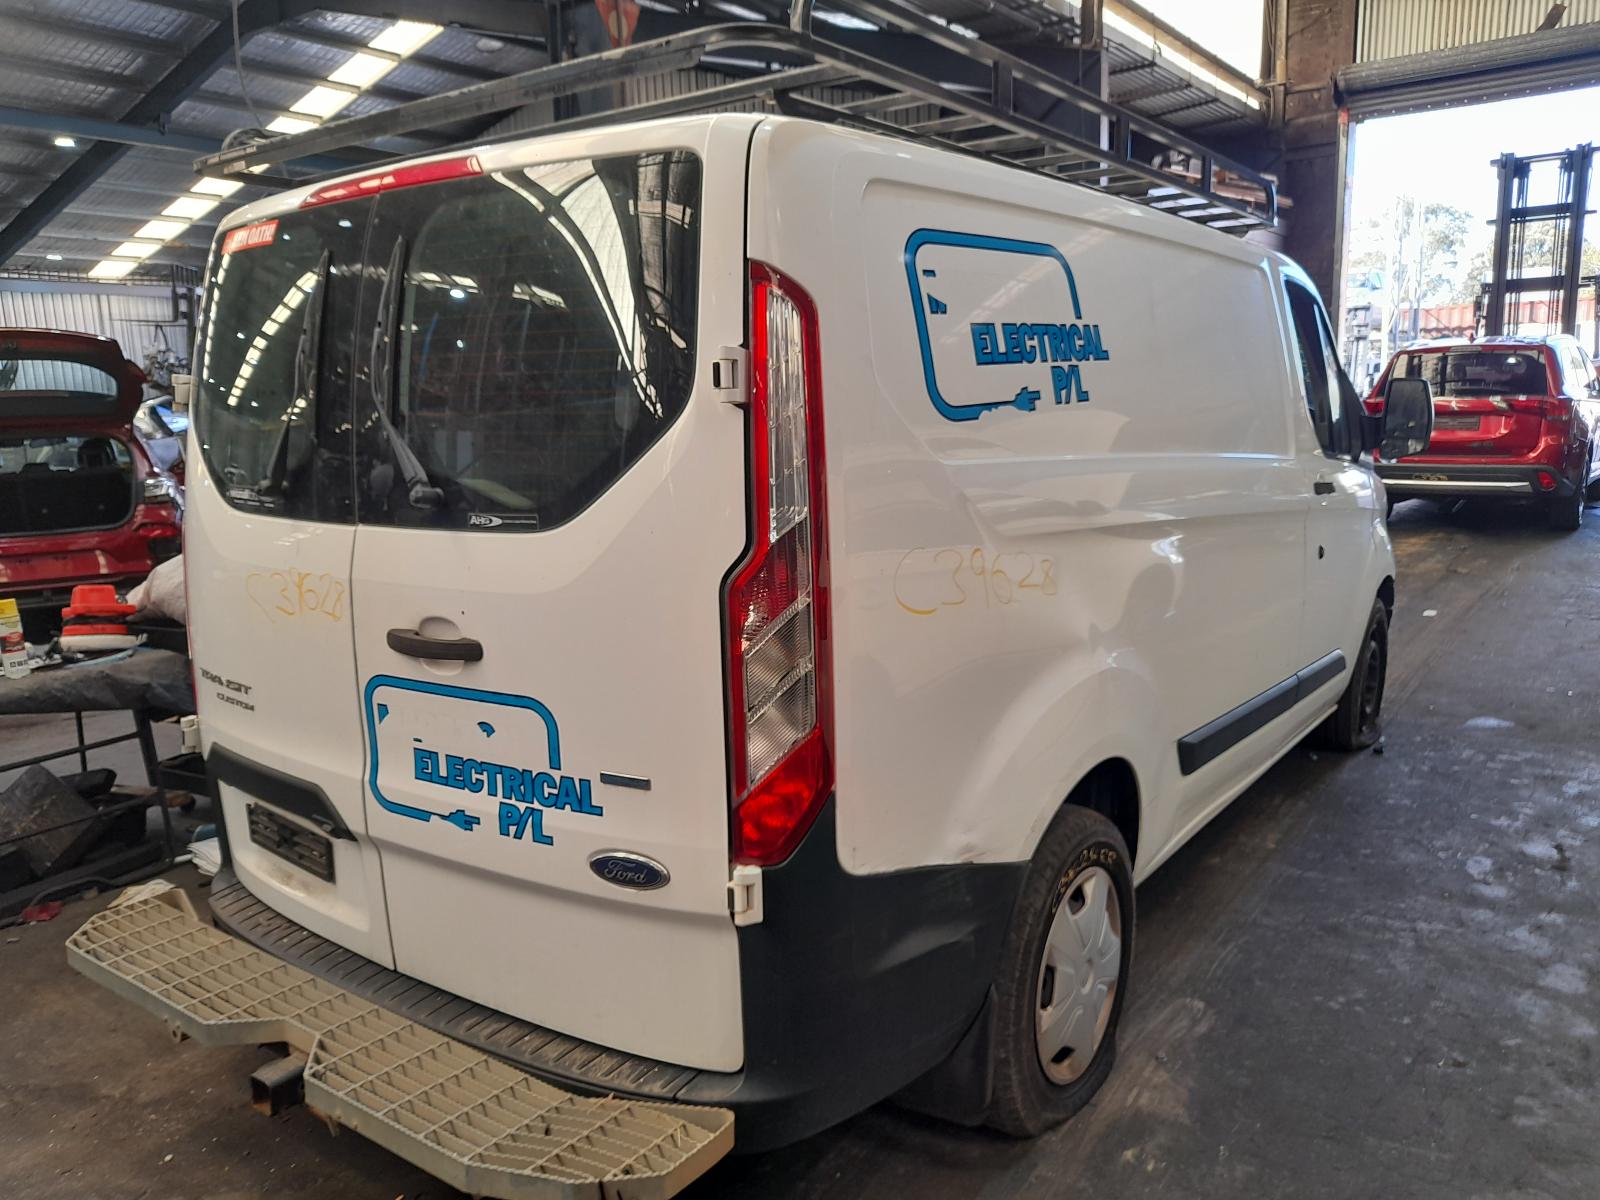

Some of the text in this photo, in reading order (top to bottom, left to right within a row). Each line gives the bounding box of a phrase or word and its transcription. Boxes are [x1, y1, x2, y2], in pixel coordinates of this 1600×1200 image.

[970, 322, 1109, 366] ELECTRICAL
[1051, 364, 1090, 405] P/L
[893, 546, 1058, 615] C39628
[413, 747, 603, 817] ELECTRICAL
[498, 801, 554, 845] P/L
[604, 860, 648, 884] Ford
